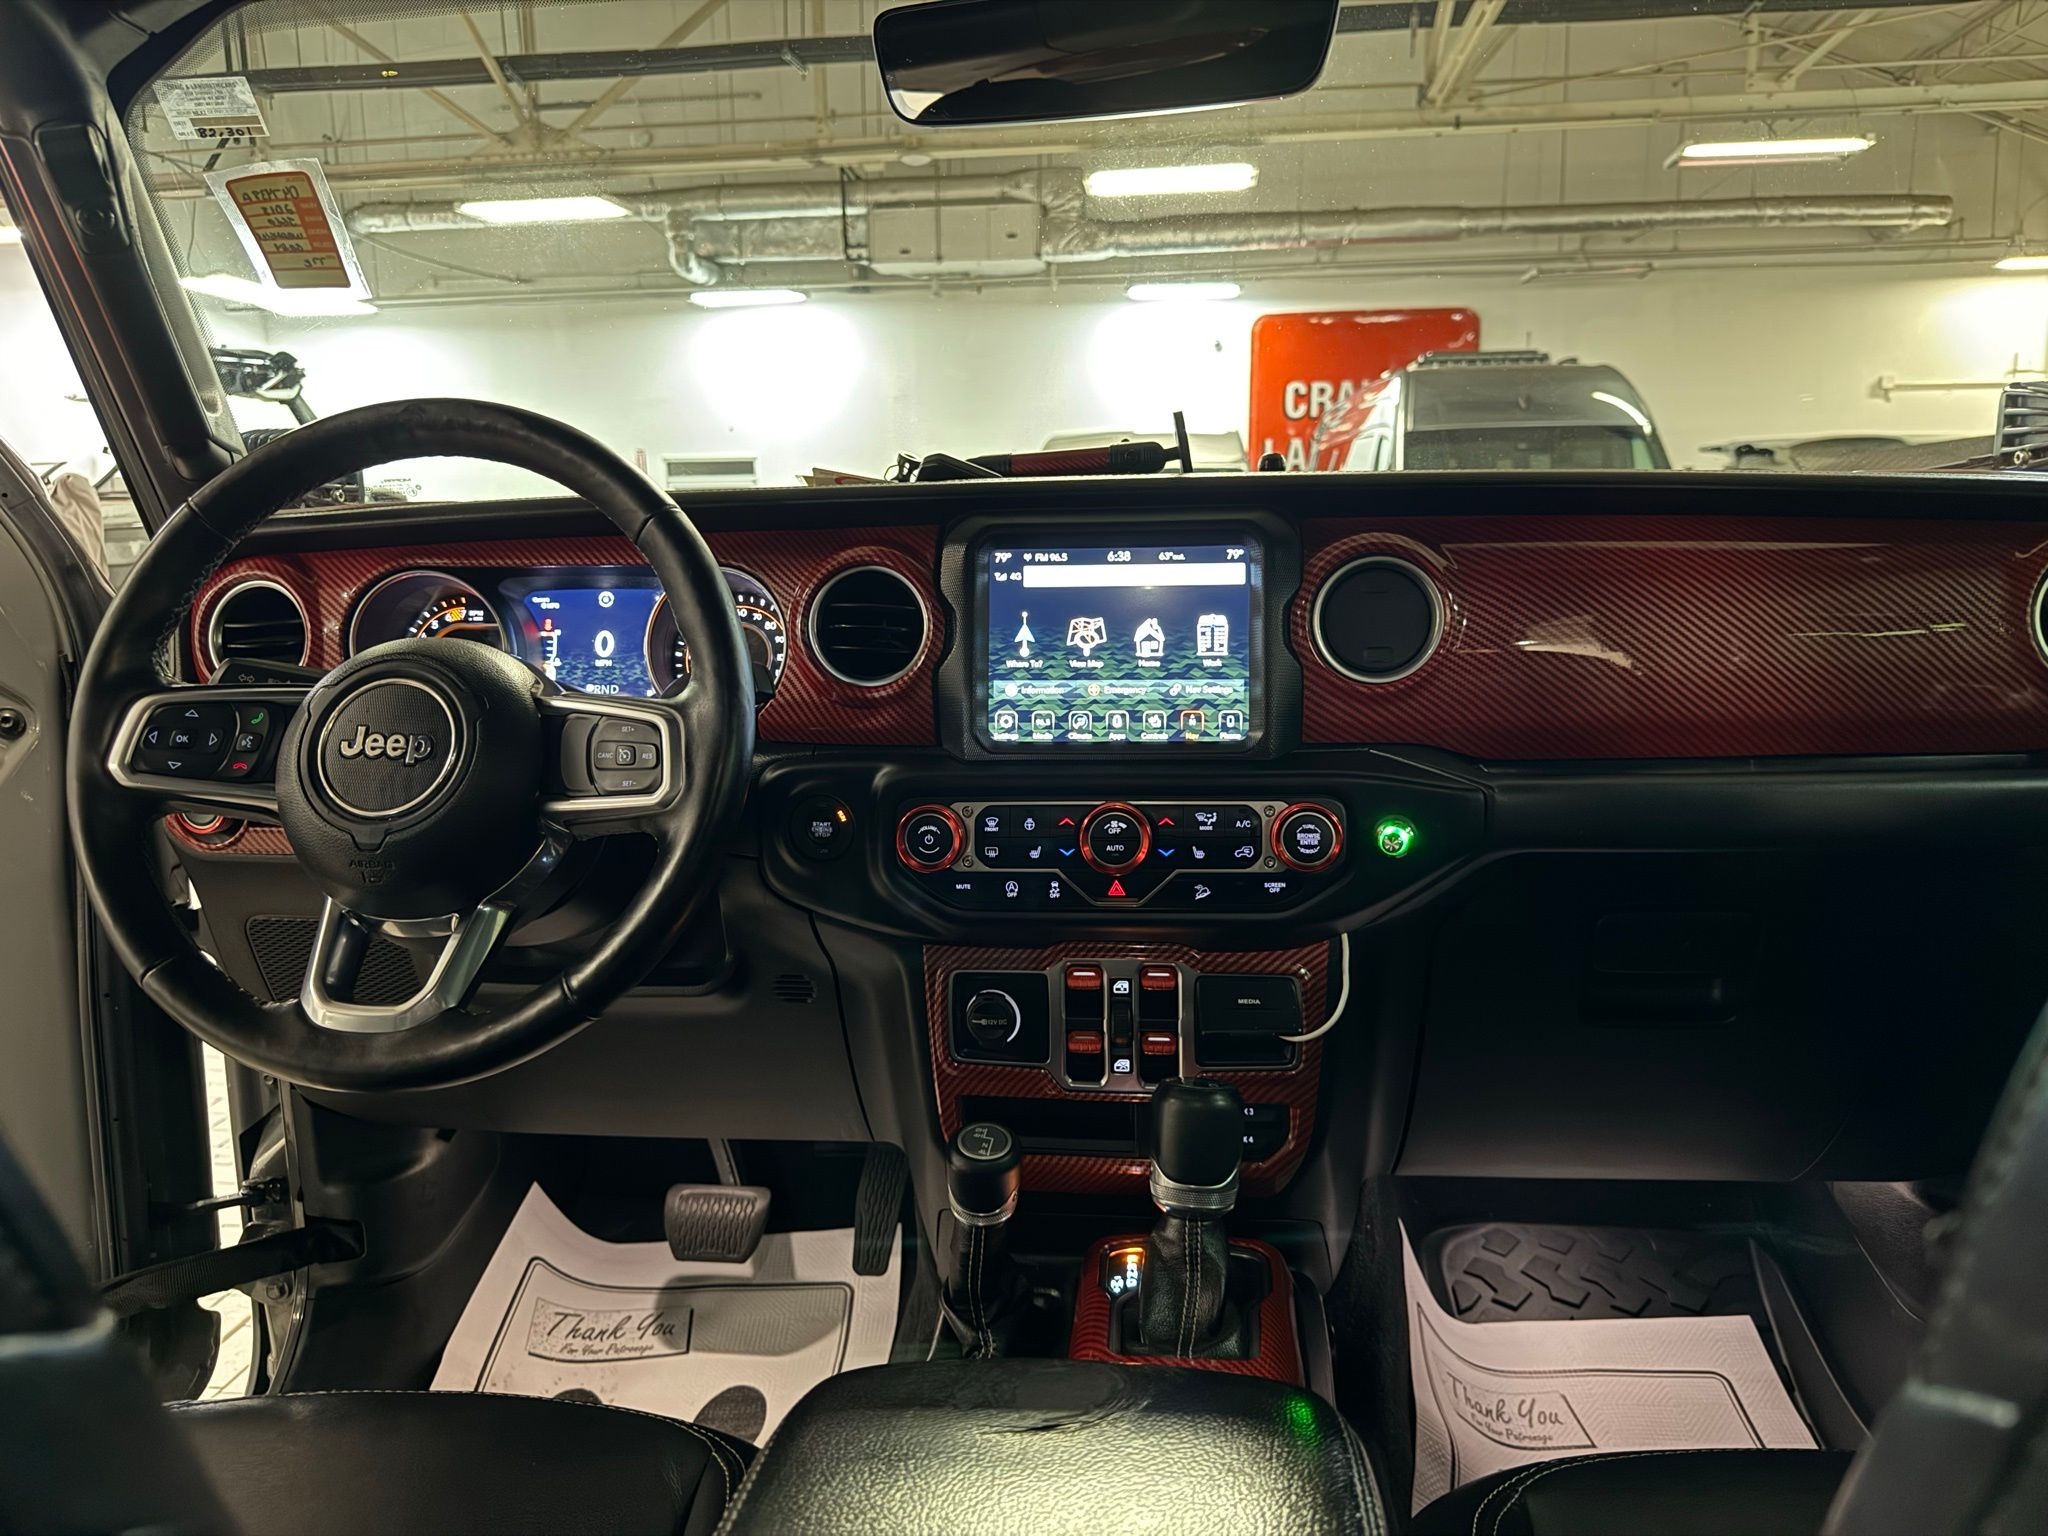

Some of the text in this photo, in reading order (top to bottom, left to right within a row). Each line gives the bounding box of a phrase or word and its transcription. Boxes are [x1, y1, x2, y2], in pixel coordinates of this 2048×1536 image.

[197, 127, 252, 138] 82,301
[1284, 380, 1360, 419] CRA
[1107, 550, 1131, 562] 6:38
[752, 613, 763, 621] 70
[764, 621, 777, 630] 80
[594, 629, 615, 658] 0
[175, 735, 189, 743] OK
[339, 725, 434, 766] Jeep
[1235, 819, 1251, 828] A/C
[1106, 844, 1125, 852] AUTO
[547, 1311, 676, 1343] Thank You
[1447, 1372, 1564, 1428] Thank You
